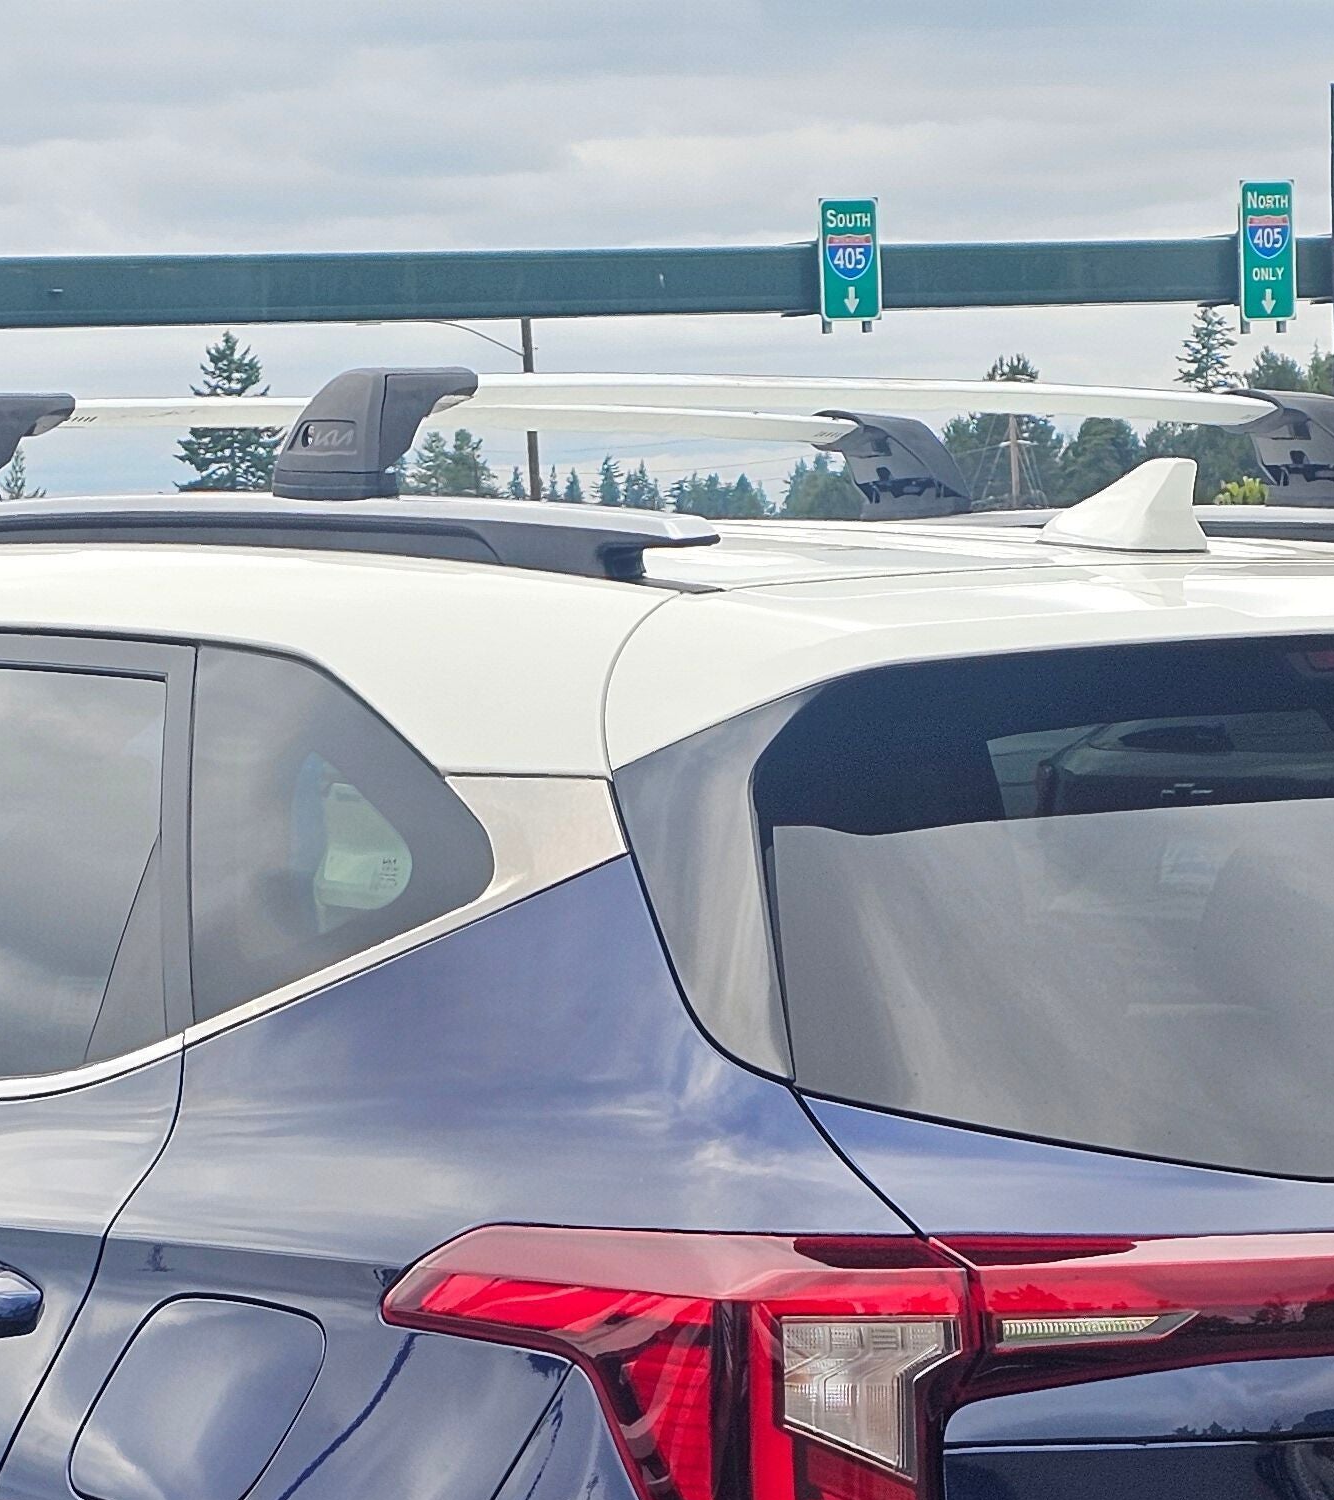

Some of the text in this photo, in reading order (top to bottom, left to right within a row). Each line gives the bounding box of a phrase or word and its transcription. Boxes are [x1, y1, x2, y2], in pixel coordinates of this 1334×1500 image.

[1247, 191, 1289, 209] NORTH
[826, 209, 871, 228] SOUTH
[1253, 227, 1283, 249] 405
[833, 247, 866, 269] 405
[1252, 267, 1284, 281] ONLY
